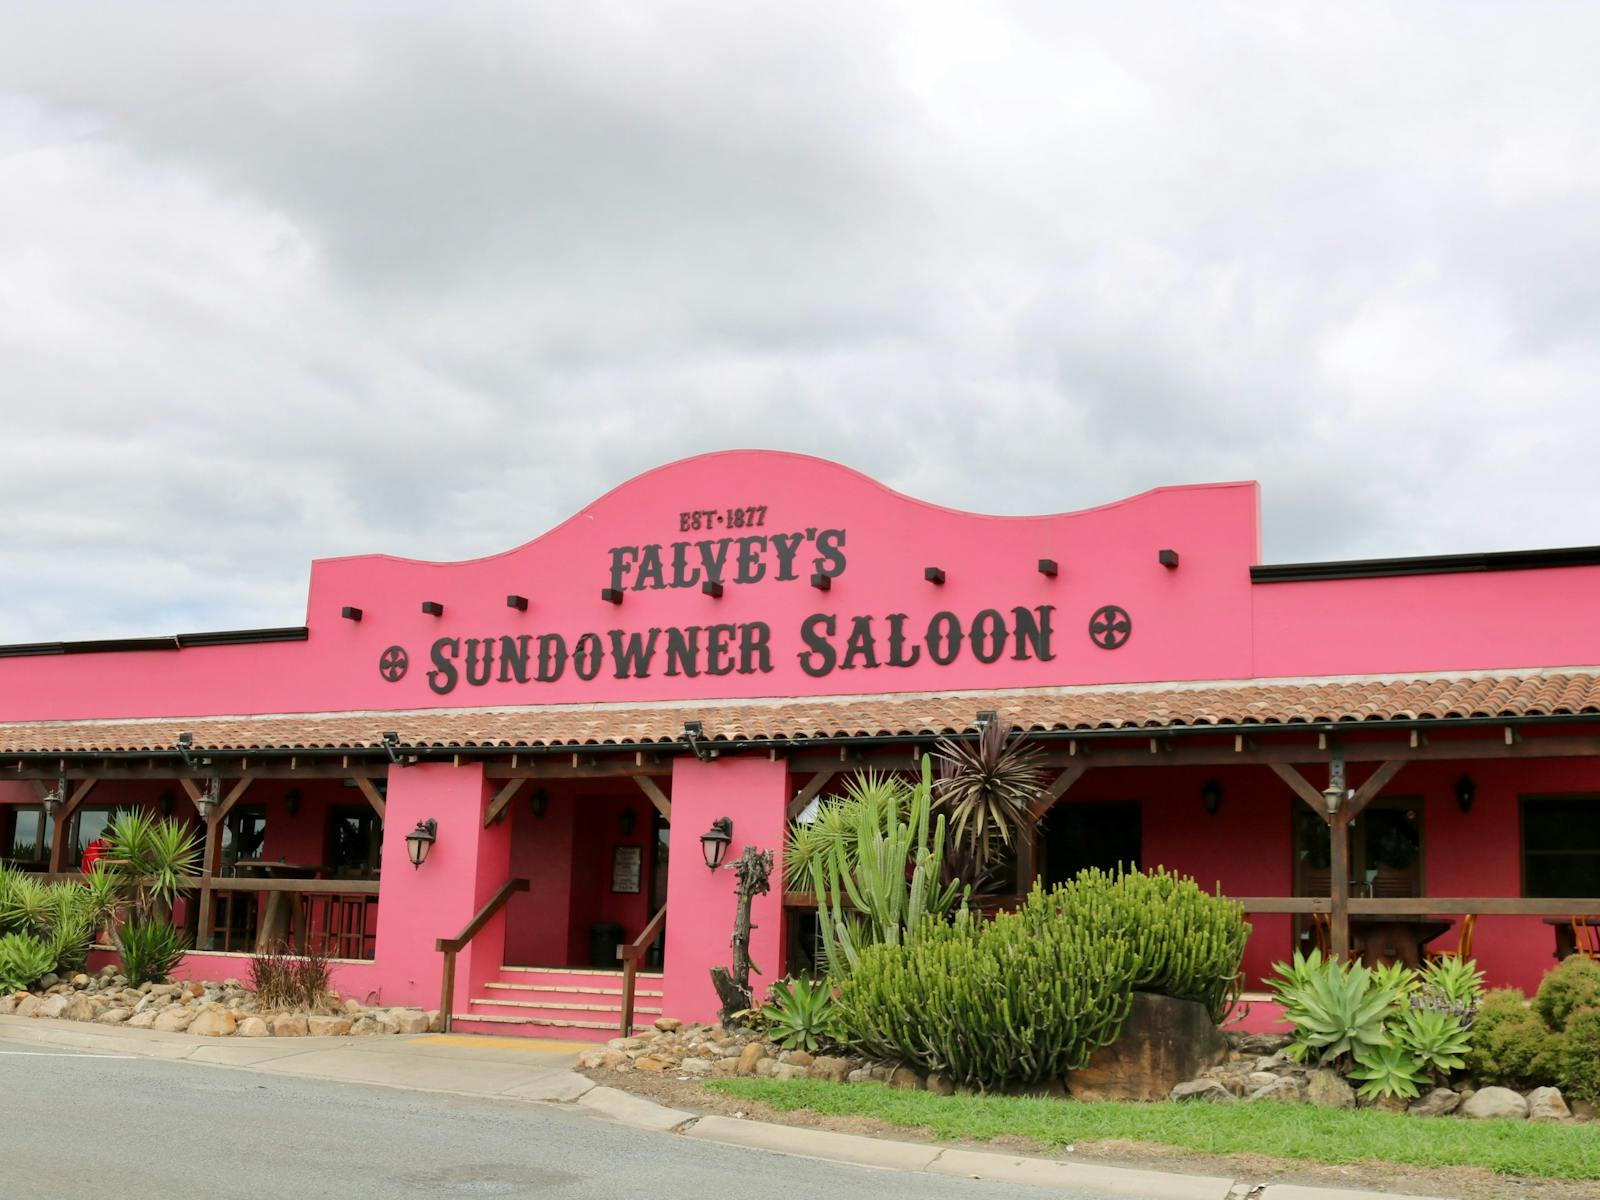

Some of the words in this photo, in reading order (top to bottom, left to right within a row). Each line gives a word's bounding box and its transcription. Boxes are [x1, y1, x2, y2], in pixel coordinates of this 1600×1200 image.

[607, 527, 847, 592] FALVEY'S
[426, 621, 774, 695] SUNDOWNER
[797, 604, 1057, 679] SALOON
